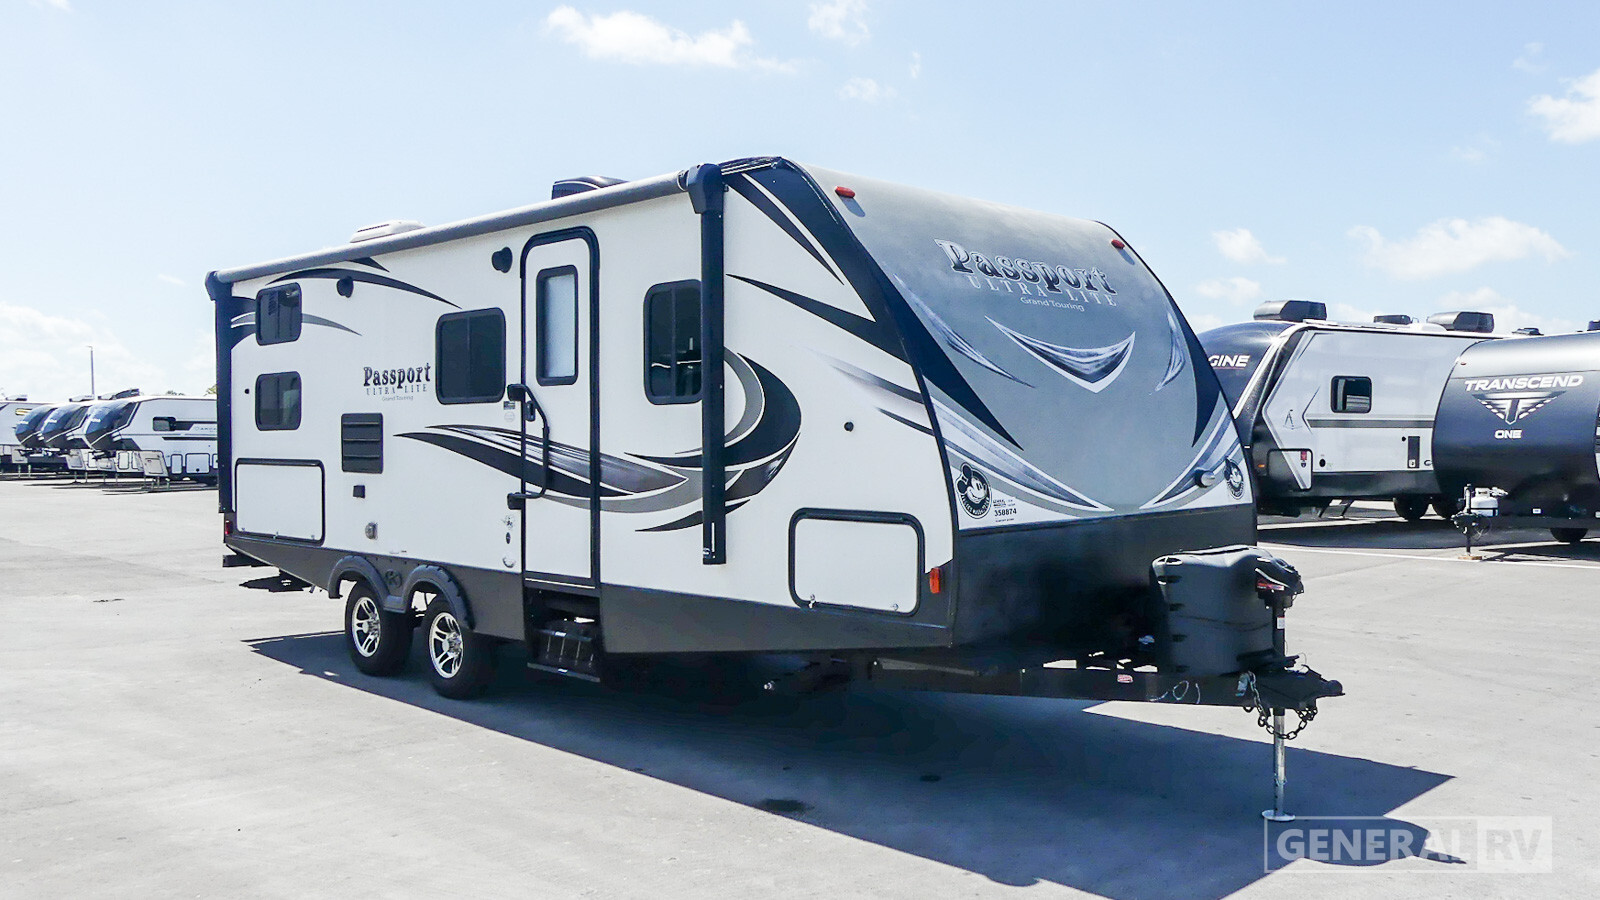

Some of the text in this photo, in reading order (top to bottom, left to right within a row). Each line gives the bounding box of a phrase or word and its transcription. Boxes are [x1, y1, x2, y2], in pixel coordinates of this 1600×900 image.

[934, 238, 1117, 295] Passport
[968, 275, 1117, 306] ULTRA LITE
[1020, 297, 1085, 312] Grand Touring
[363, 362, 431, 389] Passport
[1464, 375, 1583, 391] TRANSCEND
[404, 384, 427, 393] LITE
[1494, 429, 1522, 439] ONE
